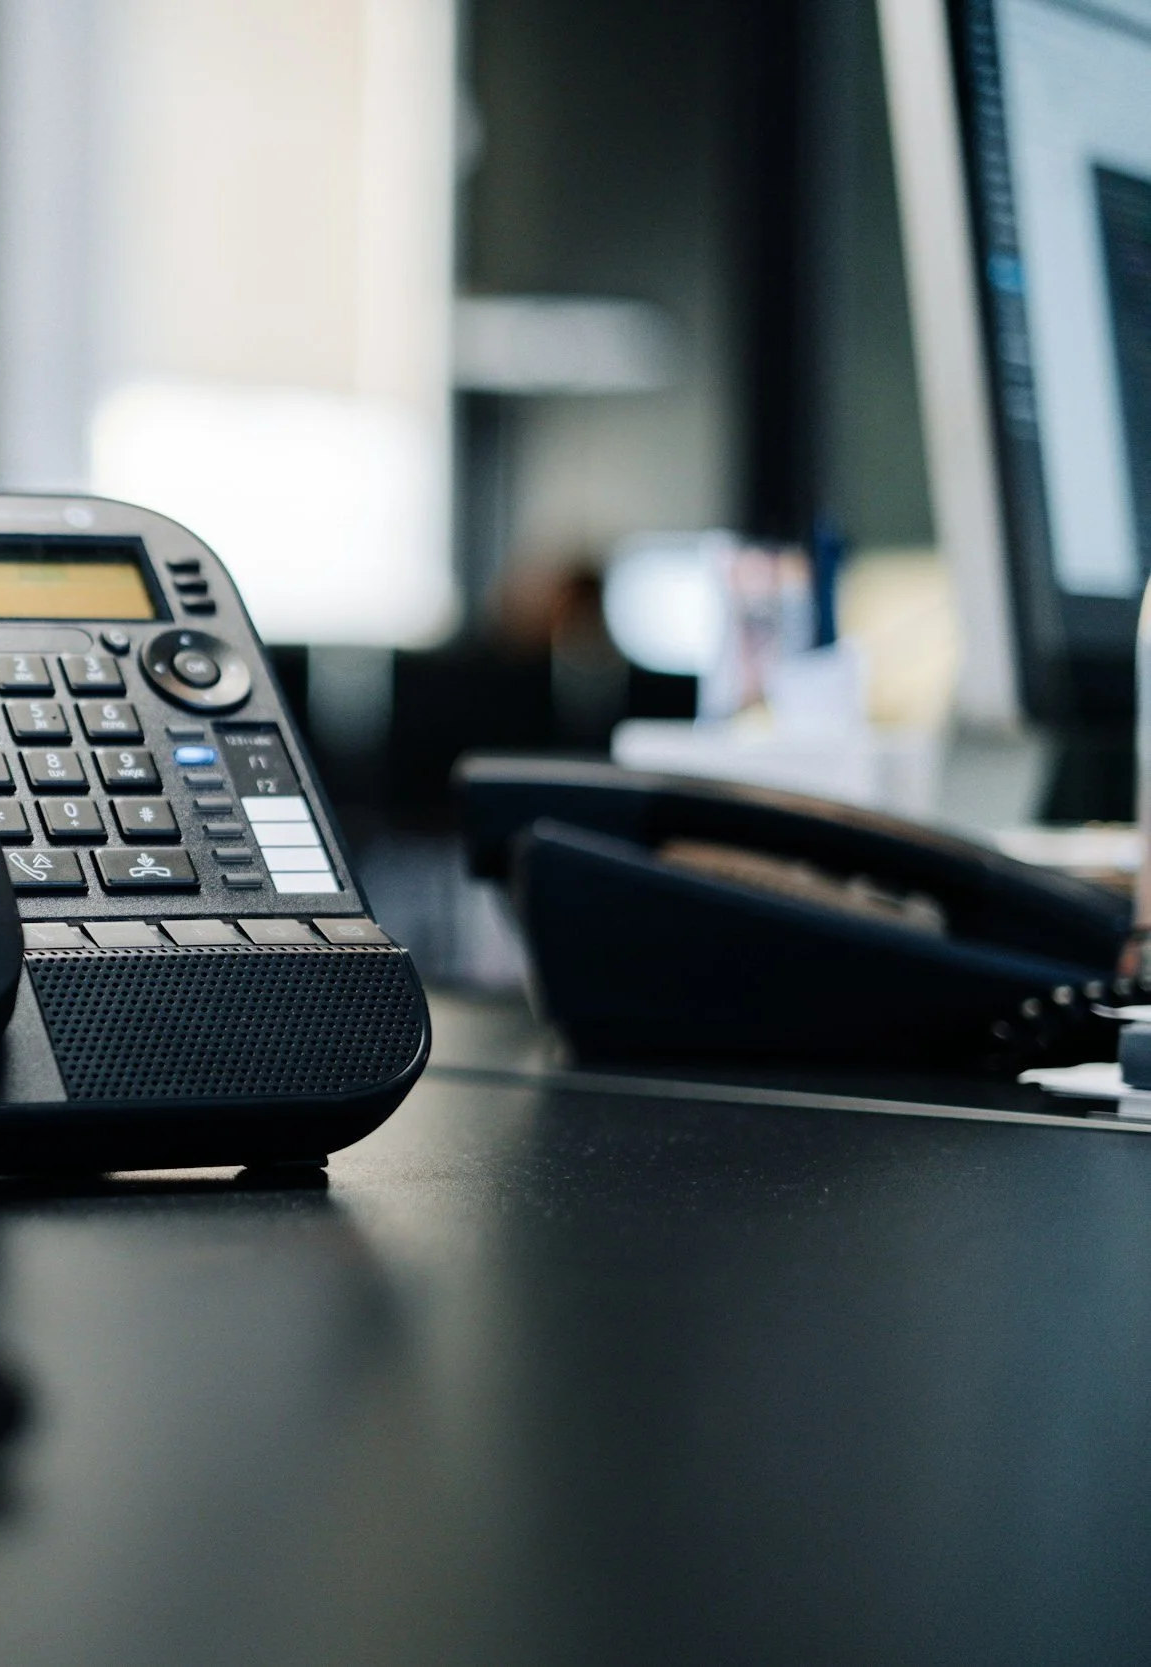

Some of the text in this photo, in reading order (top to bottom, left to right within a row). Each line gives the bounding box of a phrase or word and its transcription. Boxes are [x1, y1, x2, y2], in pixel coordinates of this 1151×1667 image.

[14, 657, 29, 671] 2
[85, 656, 99, 671] 3
[30, 704, 44, 717] 5
[102, 705, 119, 719] 6
[45, 754, 61, 768] 8
[119, 753, 135, 768] 9
[248, 755, 266, 770] F1
[48, 768, 67, 777] tuv
[256, 779, 277, 793] F2
[63, 802, 78, 818] 0
[138, 806, 155, 823] #
